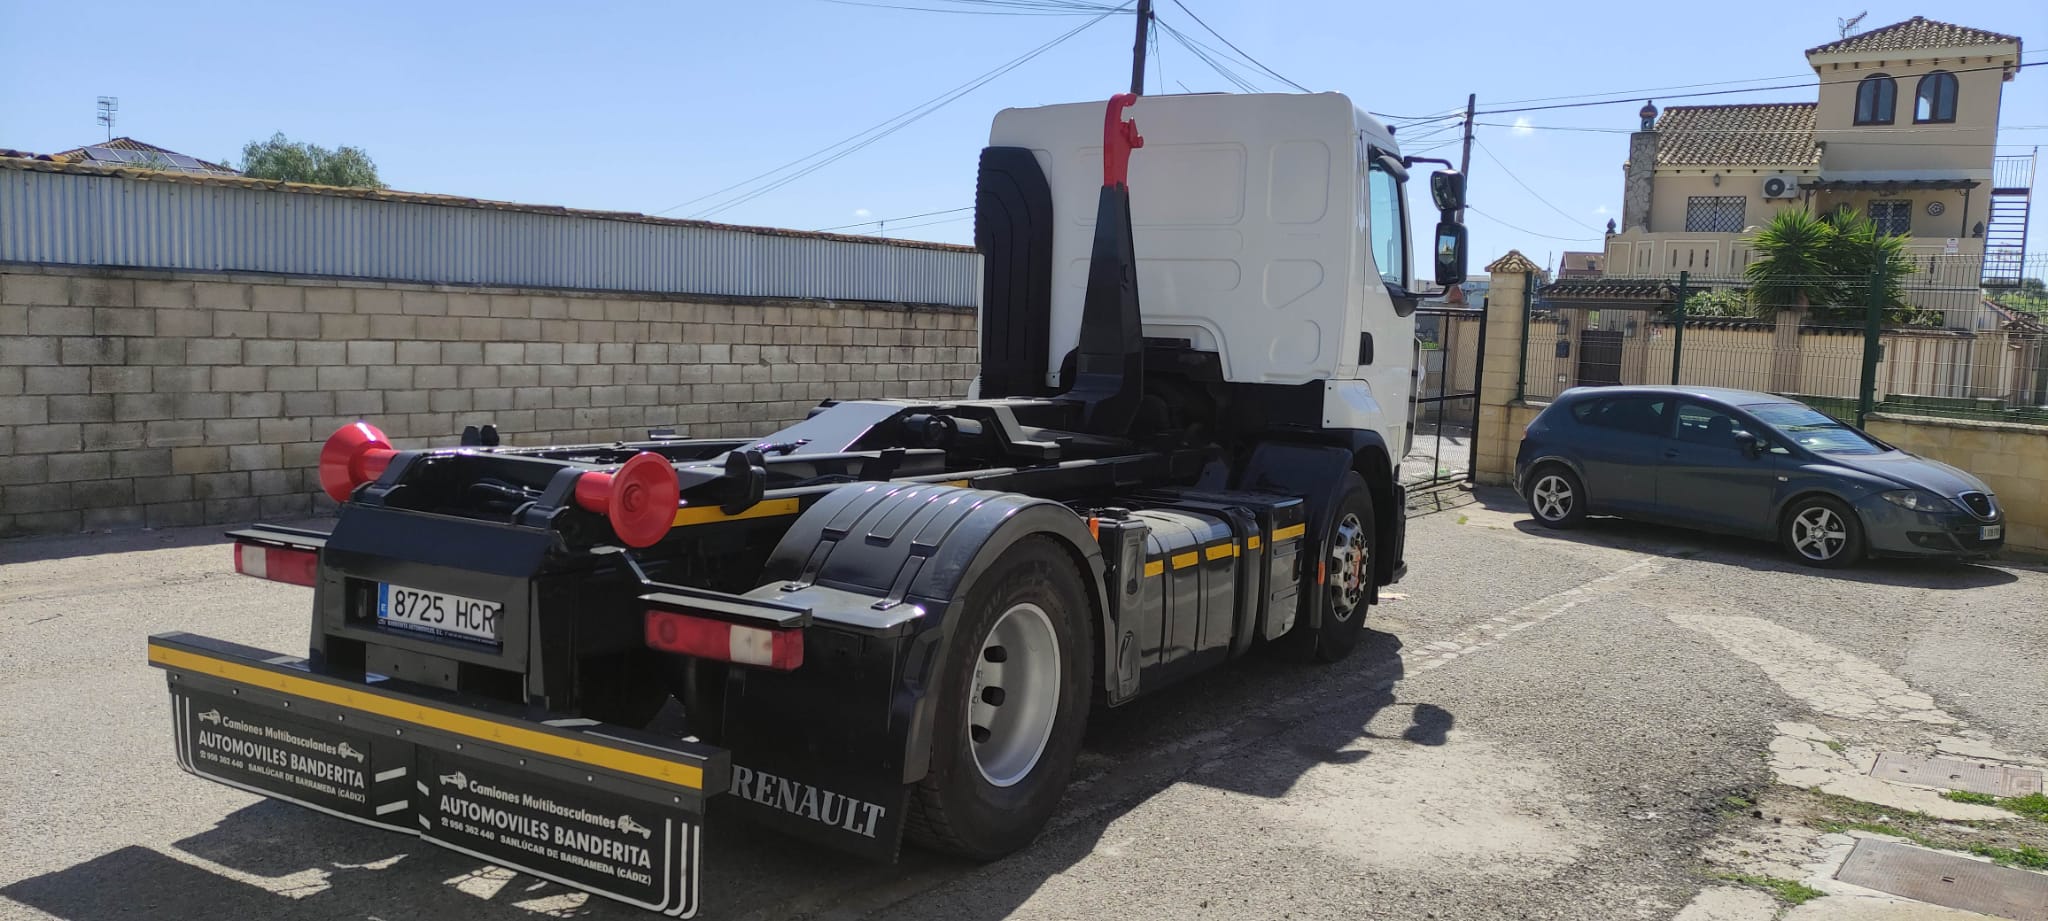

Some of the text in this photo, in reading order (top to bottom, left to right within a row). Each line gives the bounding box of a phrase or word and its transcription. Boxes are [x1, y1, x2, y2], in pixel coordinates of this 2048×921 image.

[380, 603, 387, 612] E
[394, 590, 444, 623] 8725
[455, 600, 495, 634] HCR
[199, 730, 365, 789] AUTOMOVILES BANDERITA
[222, 716, 337, 755] Camiones Multibasculantes
[206, 752, 366, 804] 956 362 440 SANLÚCAR DE BARRAMEDA (CÁDIZ)
[728, 764, 886, 838] RENAULT
[469, 780, 616, 830] Camiones Multibasculantes
[440, 795, 652, 869] AUTOMOVILES BANDERITA
[450, 821, 652, 887] 956 362 440 SANLÚCAR DE BARRAMEDA (CÁDIZ)
